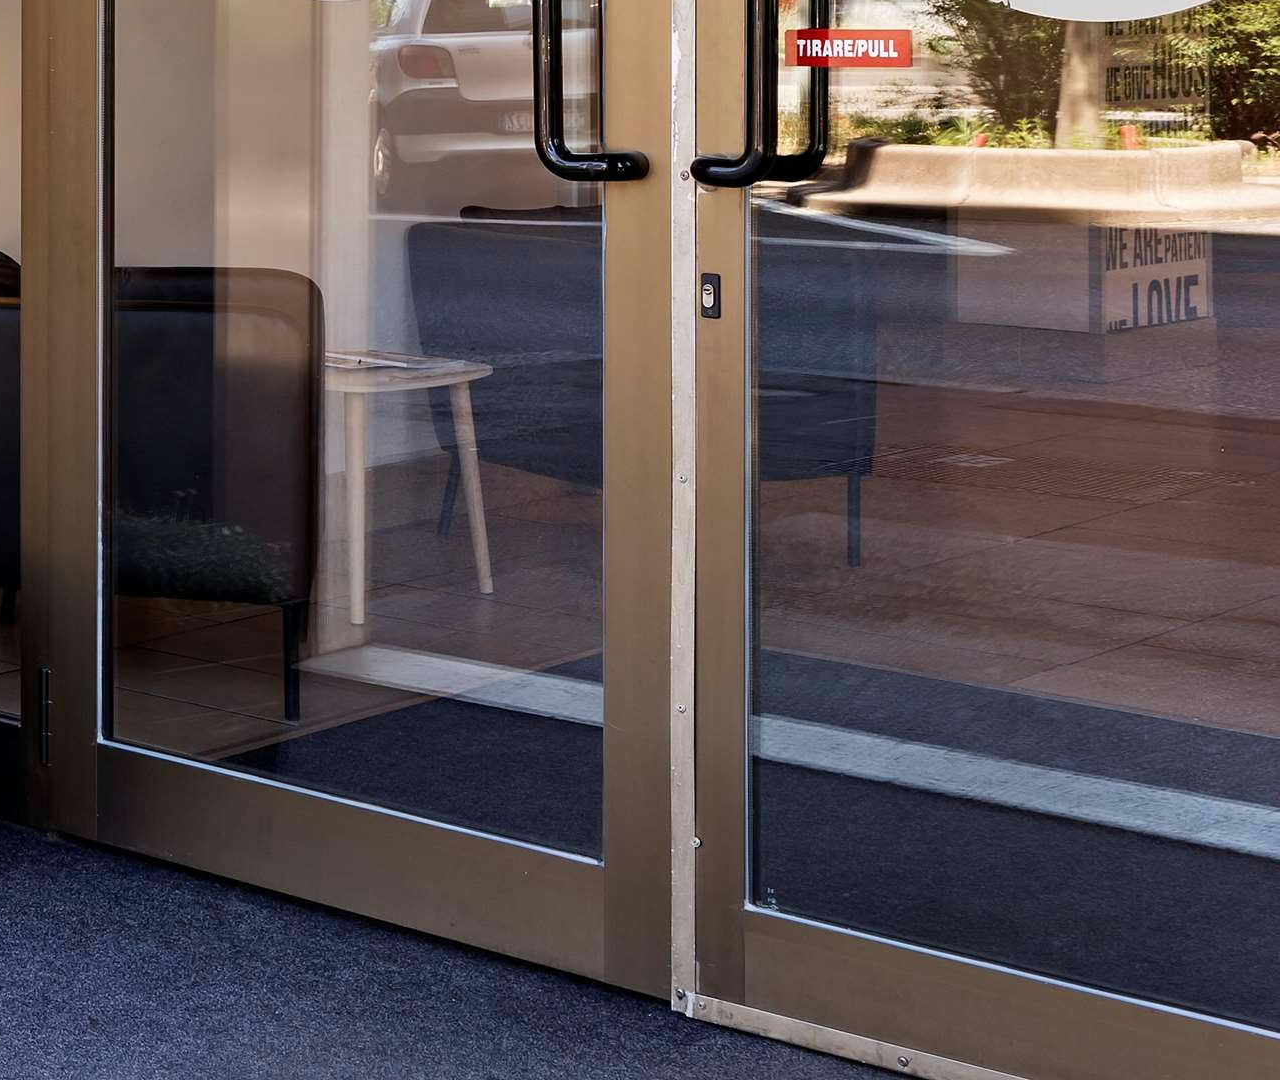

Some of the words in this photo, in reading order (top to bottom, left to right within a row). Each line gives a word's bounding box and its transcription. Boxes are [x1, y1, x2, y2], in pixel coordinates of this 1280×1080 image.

[797, 39, 898, 57] TIRARE/PULL
[1105, 226, 1128, 271] WE
[1133, 228, 1163, 267] ARE
[1164, 231, 1207, 263] PATIENT
